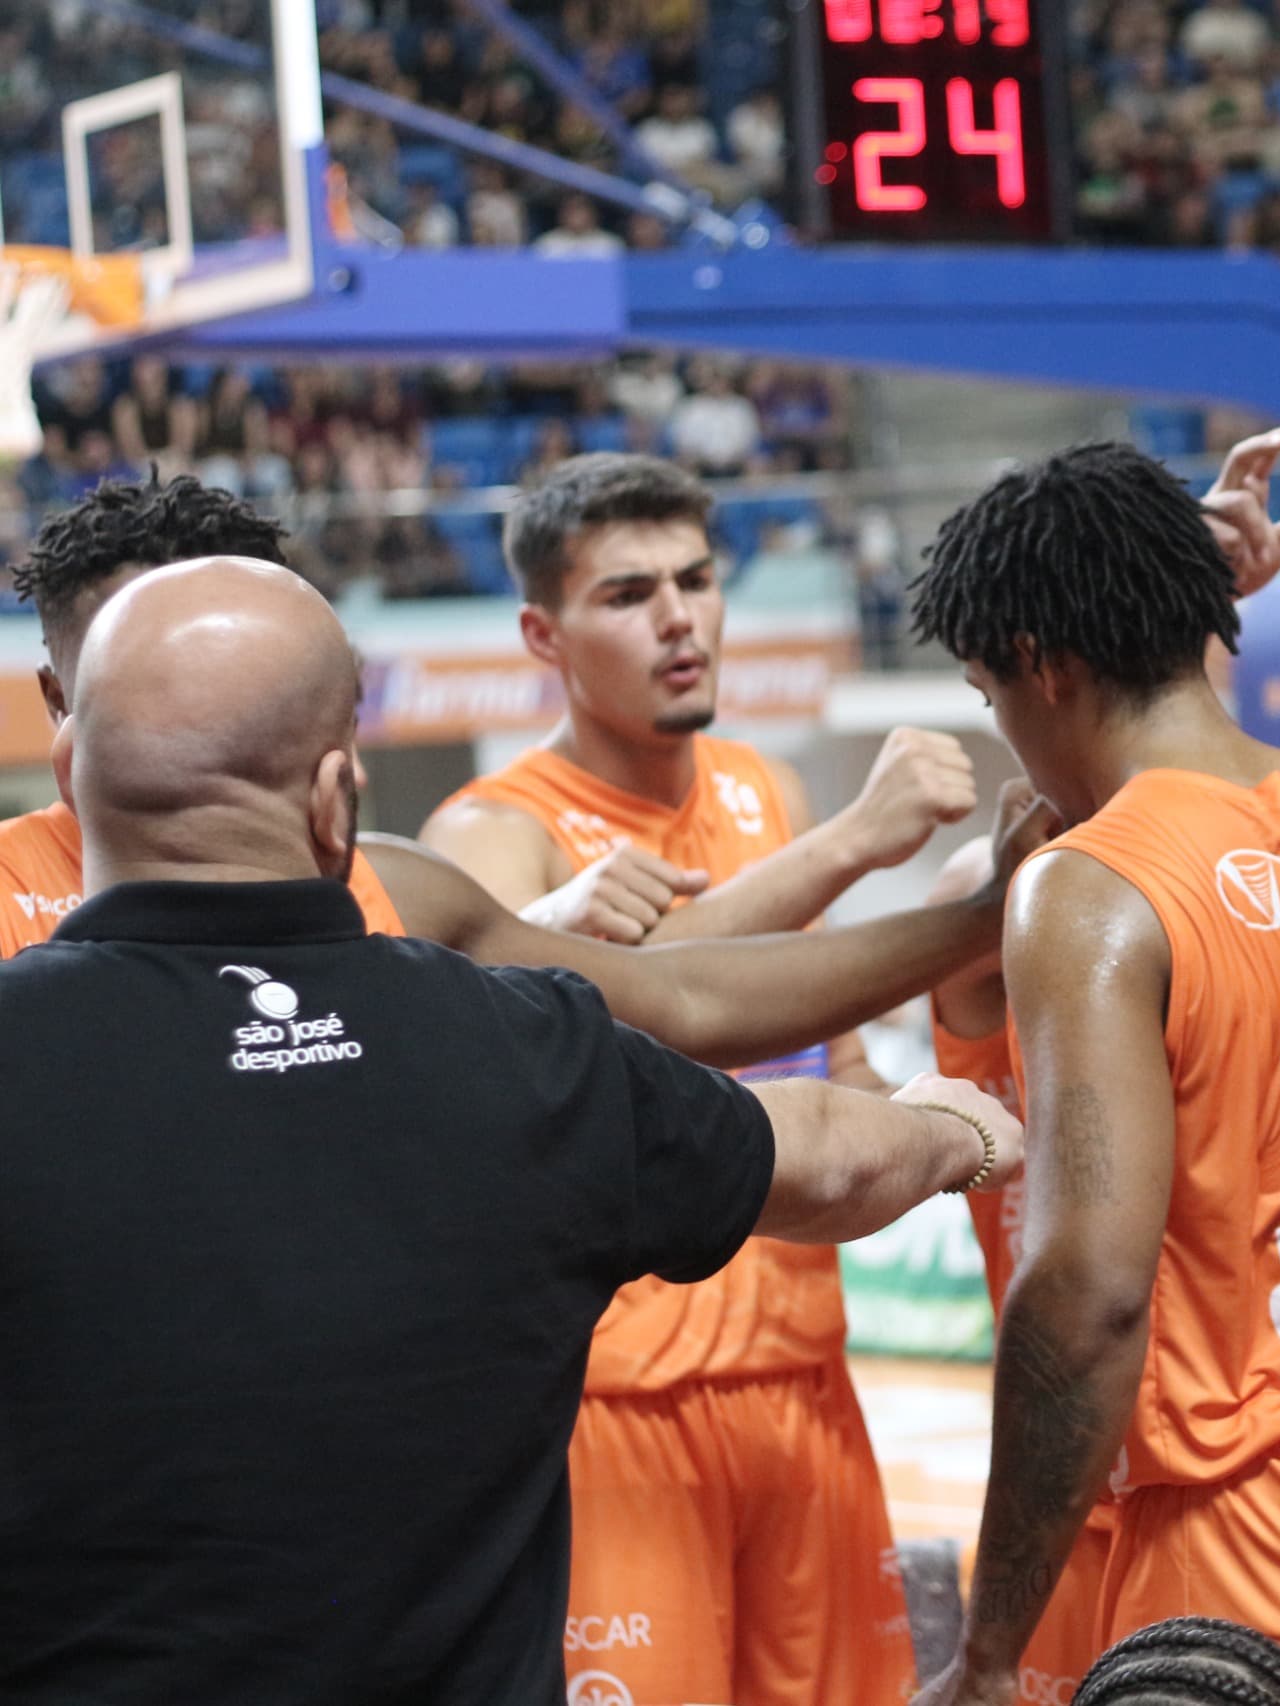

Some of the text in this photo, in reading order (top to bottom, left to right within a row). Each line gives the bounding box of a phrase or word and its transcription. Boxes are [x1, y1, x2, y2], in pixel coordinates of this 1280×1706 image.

[852, 77, 1026, 211] 24
[234, 1012, 345, 1047] são josé
[231, 1040, 363, 1073] desportivo
